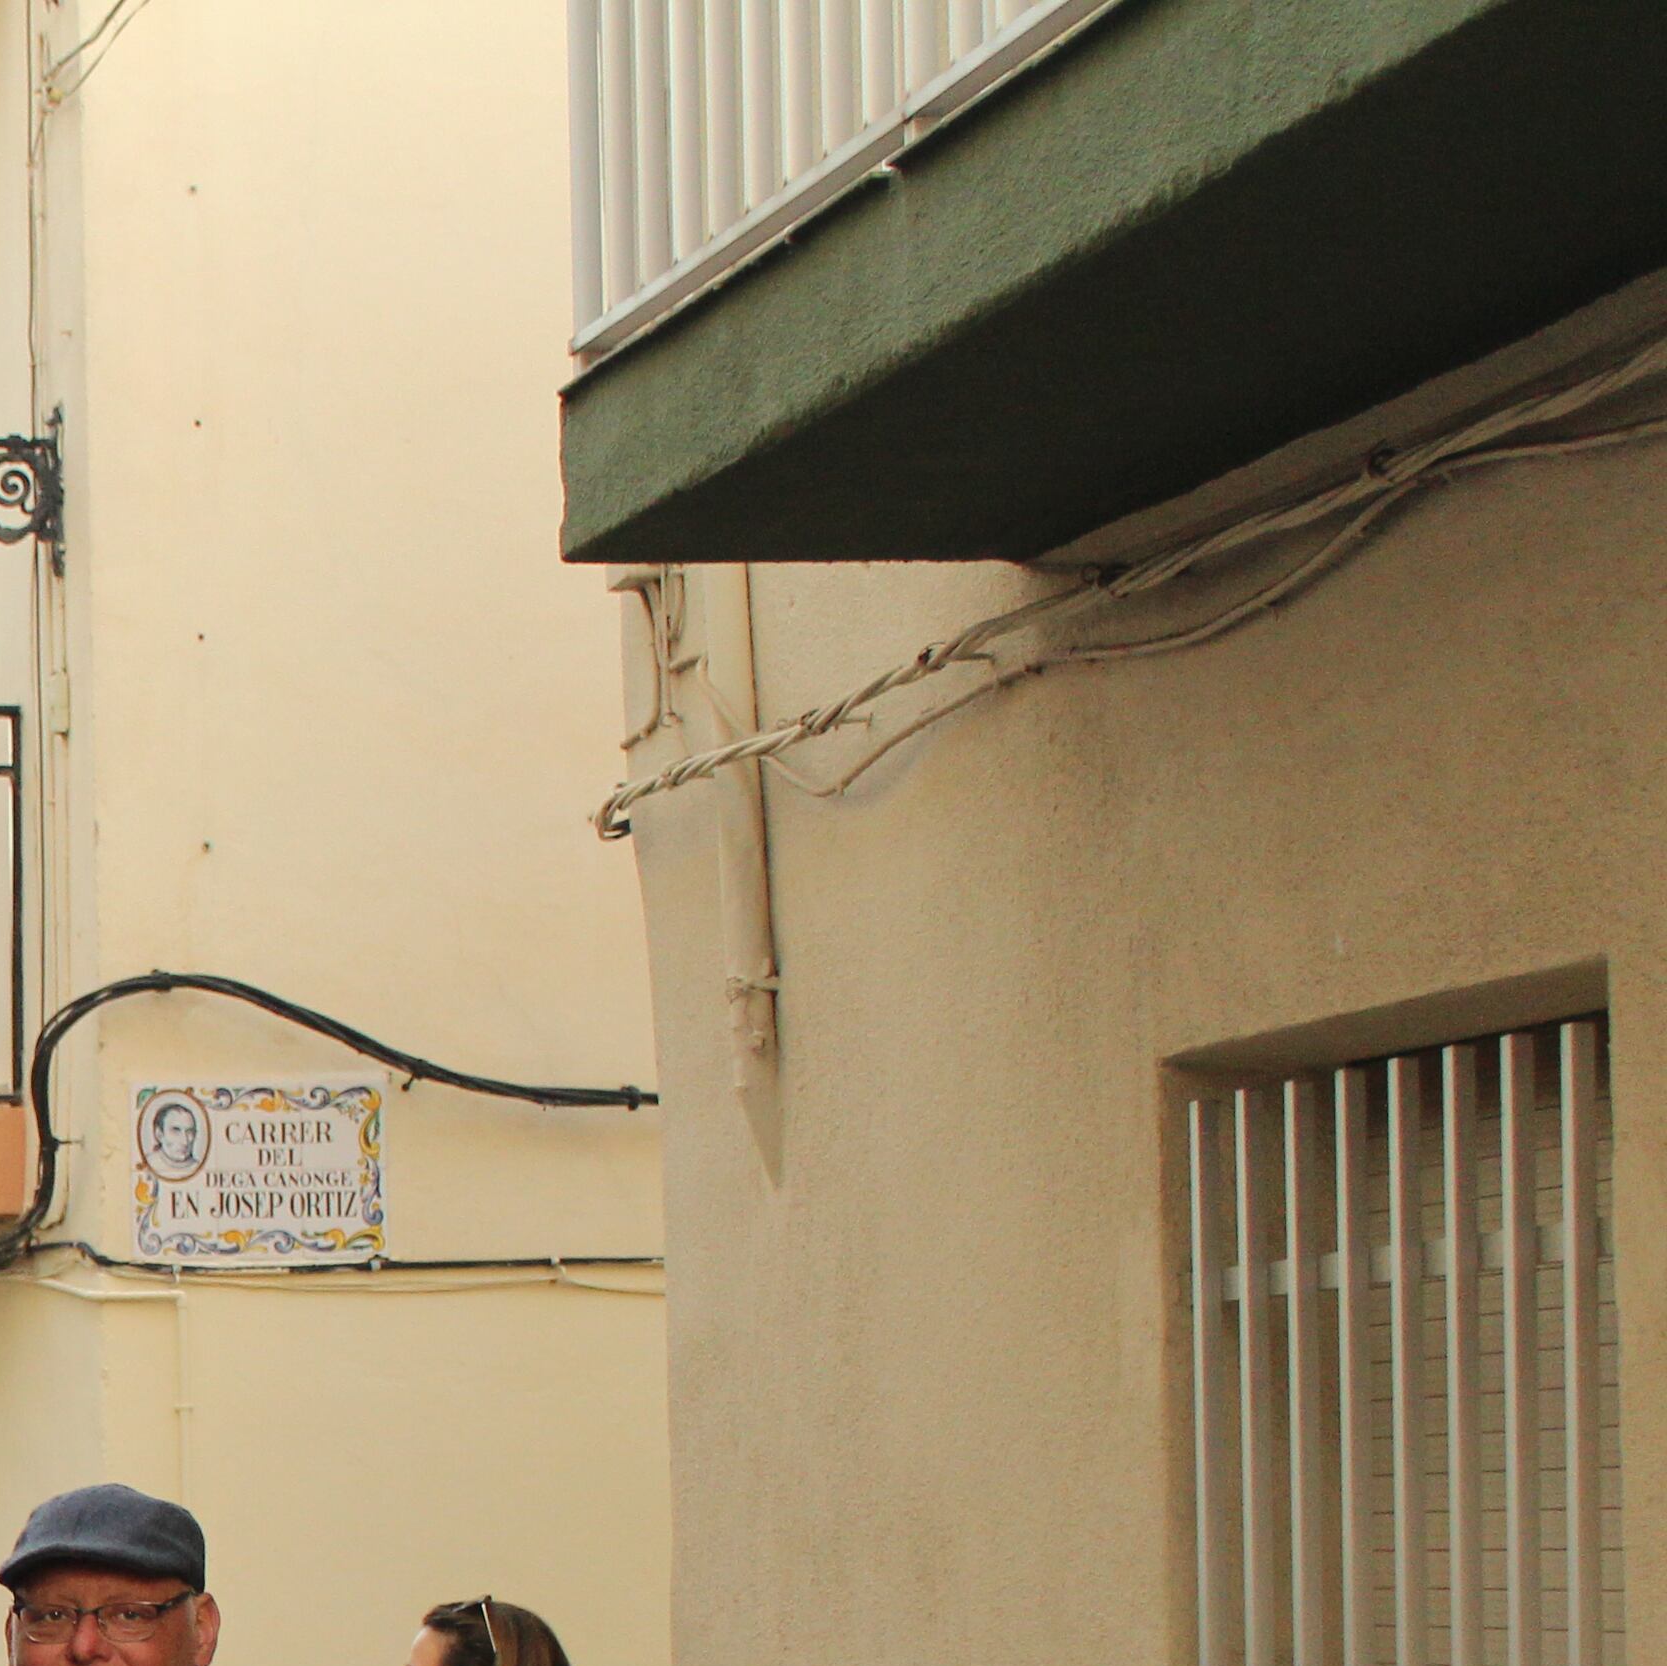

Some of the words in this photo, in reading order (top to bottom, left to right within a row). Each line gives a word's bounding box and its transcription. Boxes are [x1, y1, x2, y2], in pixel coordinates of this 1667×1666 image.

[224, 1121, 333, 1145] CARRER
[257, 1148, 303, 1167] DEL
[263, 1172, 353, 1188] CANONGE
[170, 1191, 199, 1219] EN
[210, 1190, 284, 1219] JOSEP
[289, 1190, 359, 1219] ORTIZ
